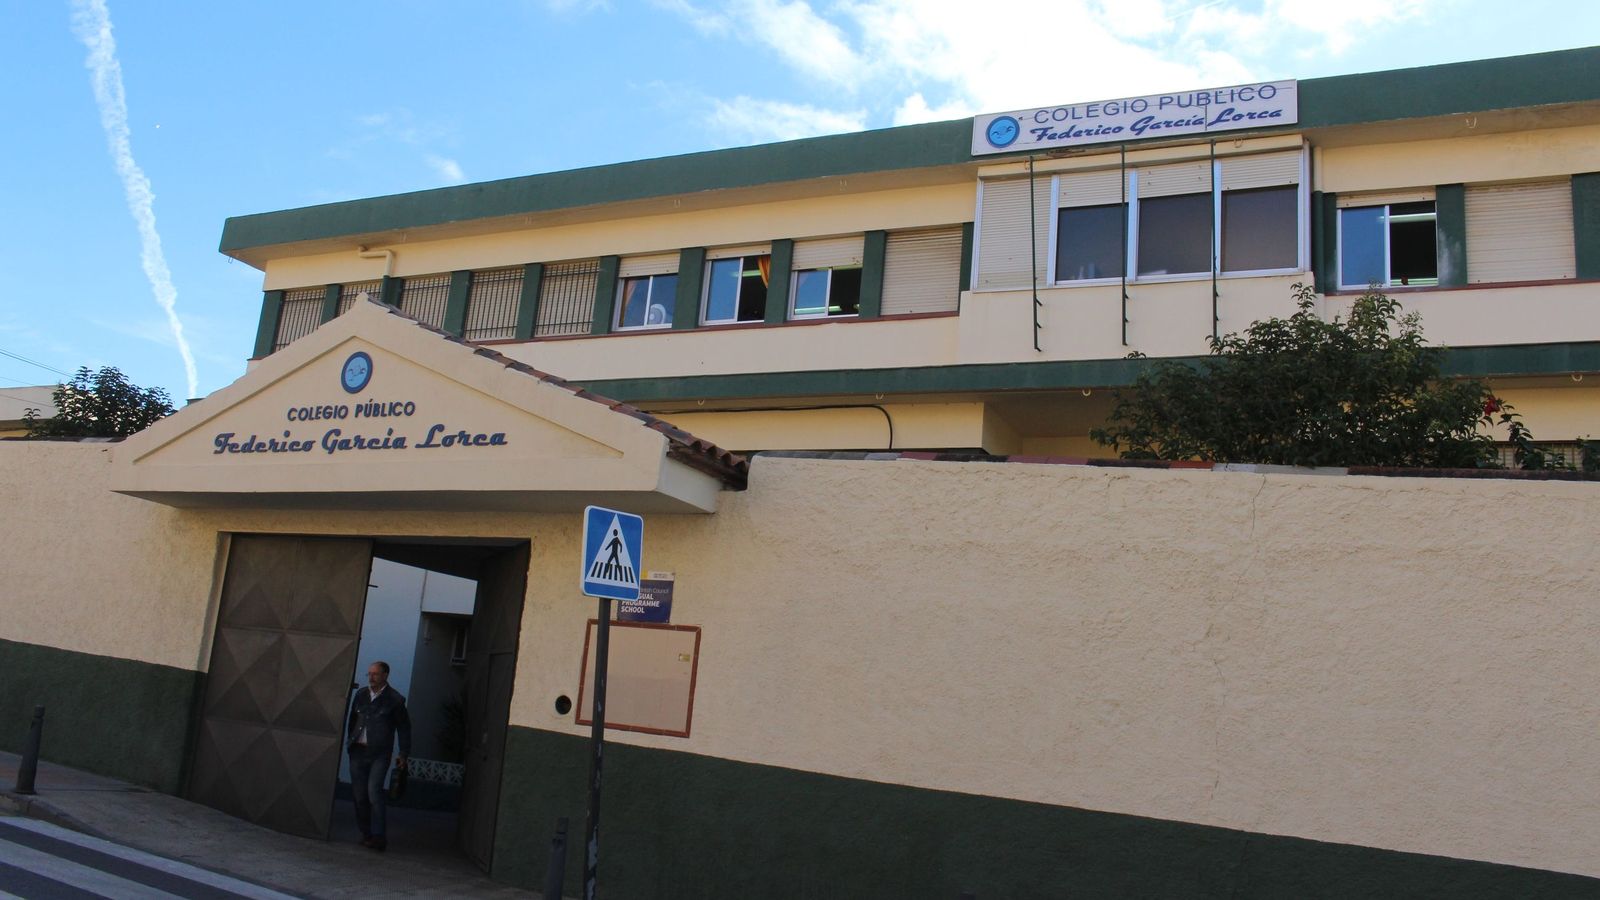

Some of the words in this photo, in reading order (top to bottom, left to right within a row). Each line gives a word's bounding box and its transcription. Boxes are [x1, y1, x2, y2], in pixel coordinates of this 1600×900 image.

[1029, 124, 1125, 142] Federico
[1207, 107, 1283, 127] Lorca
[1034, 98, 1148, 124] COLEGIO
[287, 404, 349, 422] COLEGIO
[354, 399, 416, 418] PÚBLICO
[213, 430, 317, 455] Federico
[414, 423, 508, 449] Lorca
